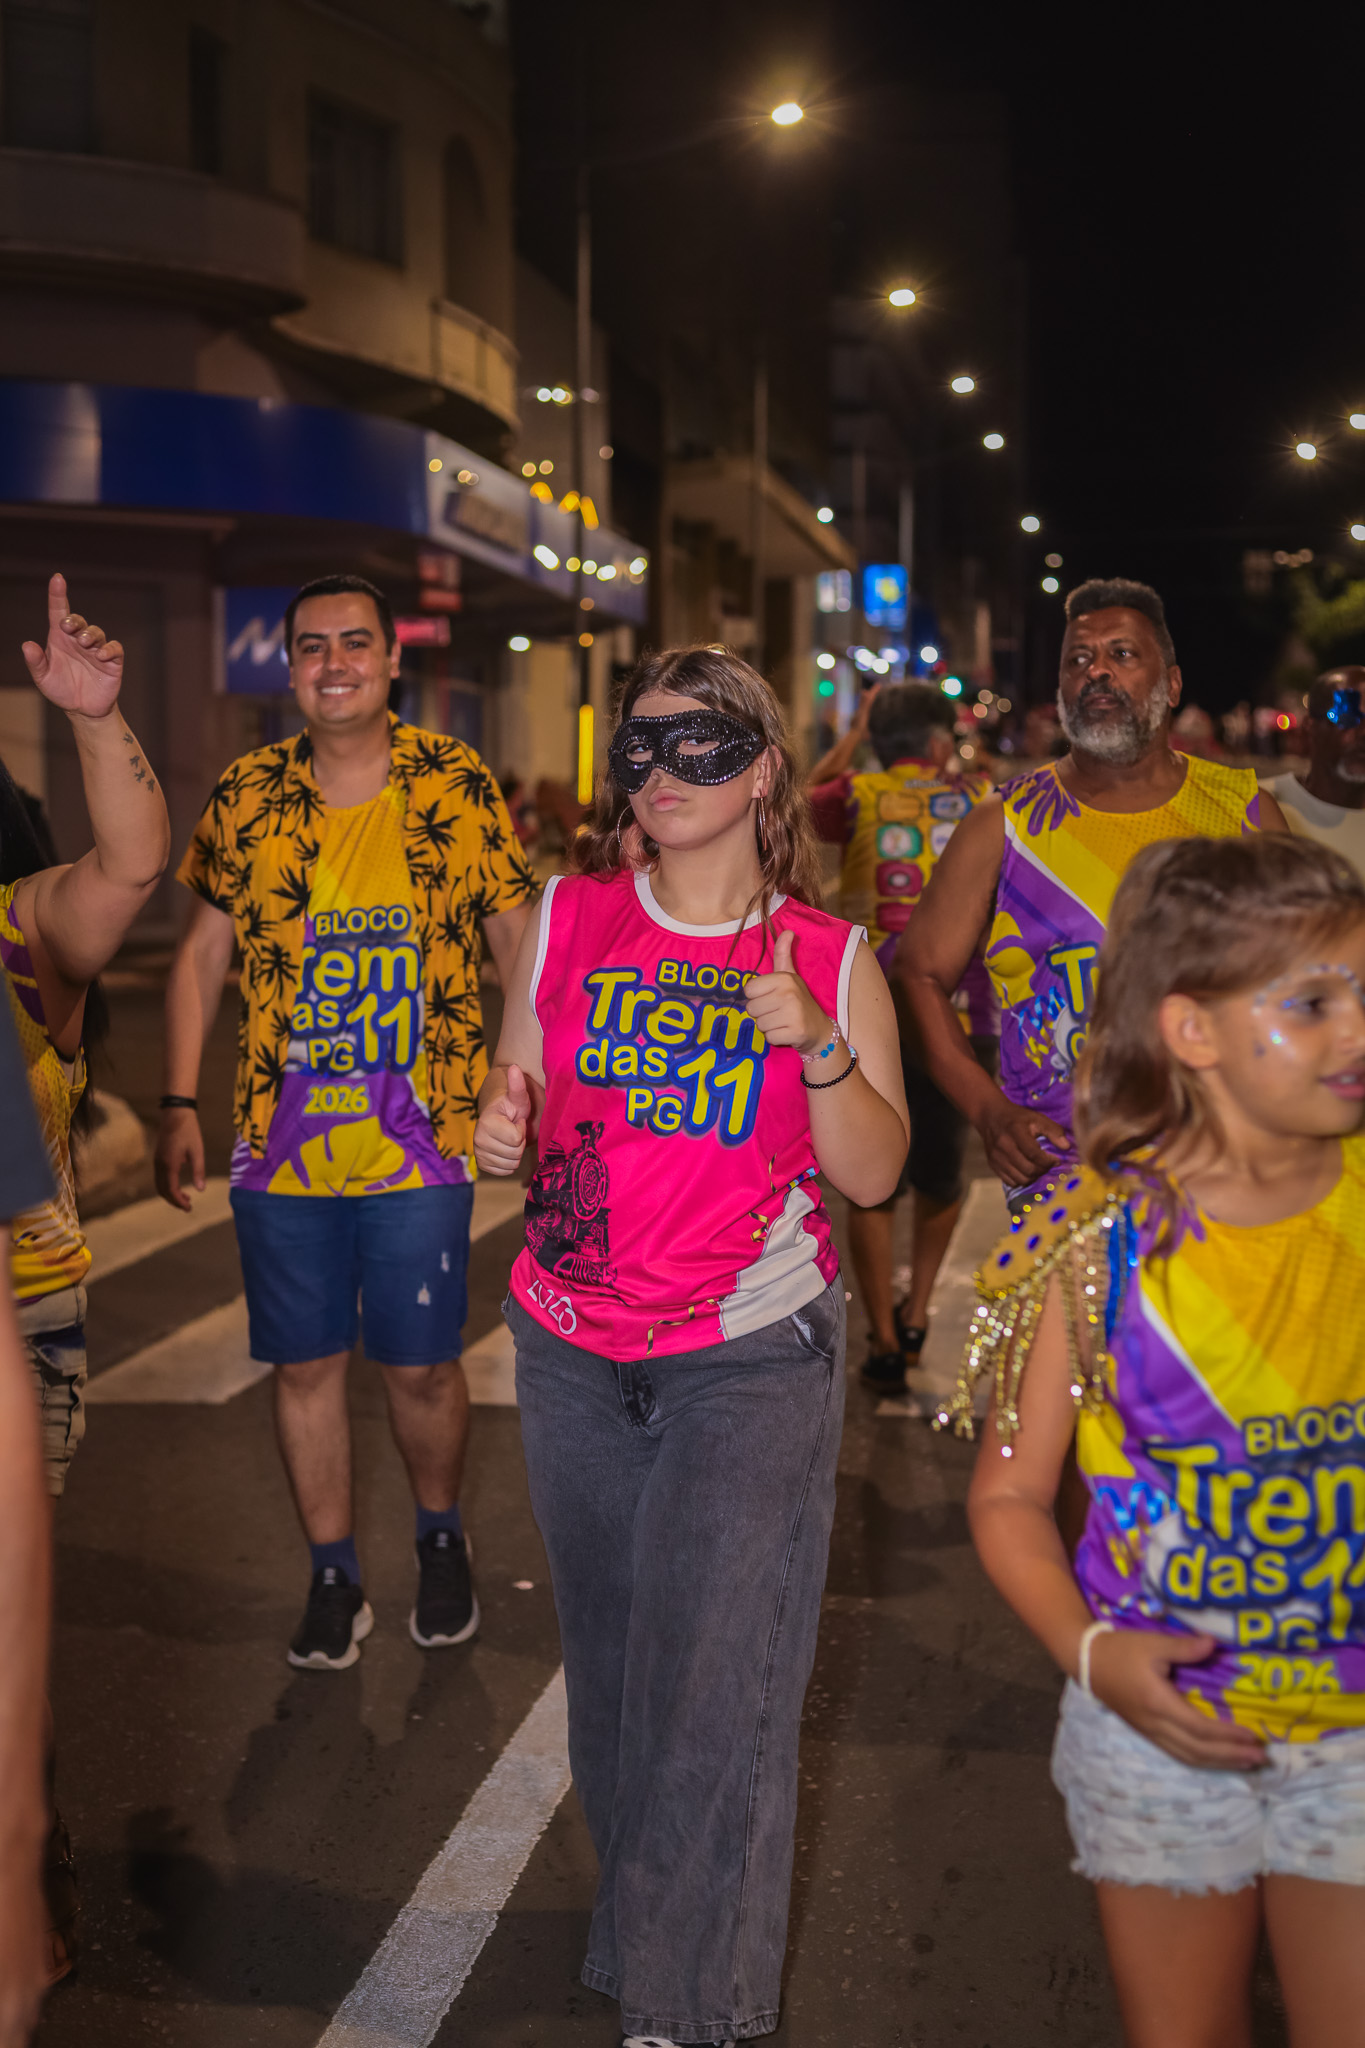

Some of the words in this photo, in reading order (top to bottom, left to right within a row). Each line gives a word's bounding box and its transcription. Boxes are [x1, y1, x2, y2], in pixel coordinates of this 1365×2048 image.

[314, 907, 409, 937] BLOCO
[296, 945, 418, 997] rem
[292, 999, 340, 1031] as
[345, 992, 412, 1065] 11
[587, 971, 767, 1055] Trem
[309, 1038, 355, 1071] PG
[303, 1085, 369, 1115] 2026
[579, 1038, 669, 1079] das
[674, 1048, 755, 1135] 11
[626, 1087, 683, 1131] PG
[1166, 1545, 1289, 1601] das
[1237, 1609, 1318, 1651] PG
[1234, 1652, 1341, 1694] 2026
